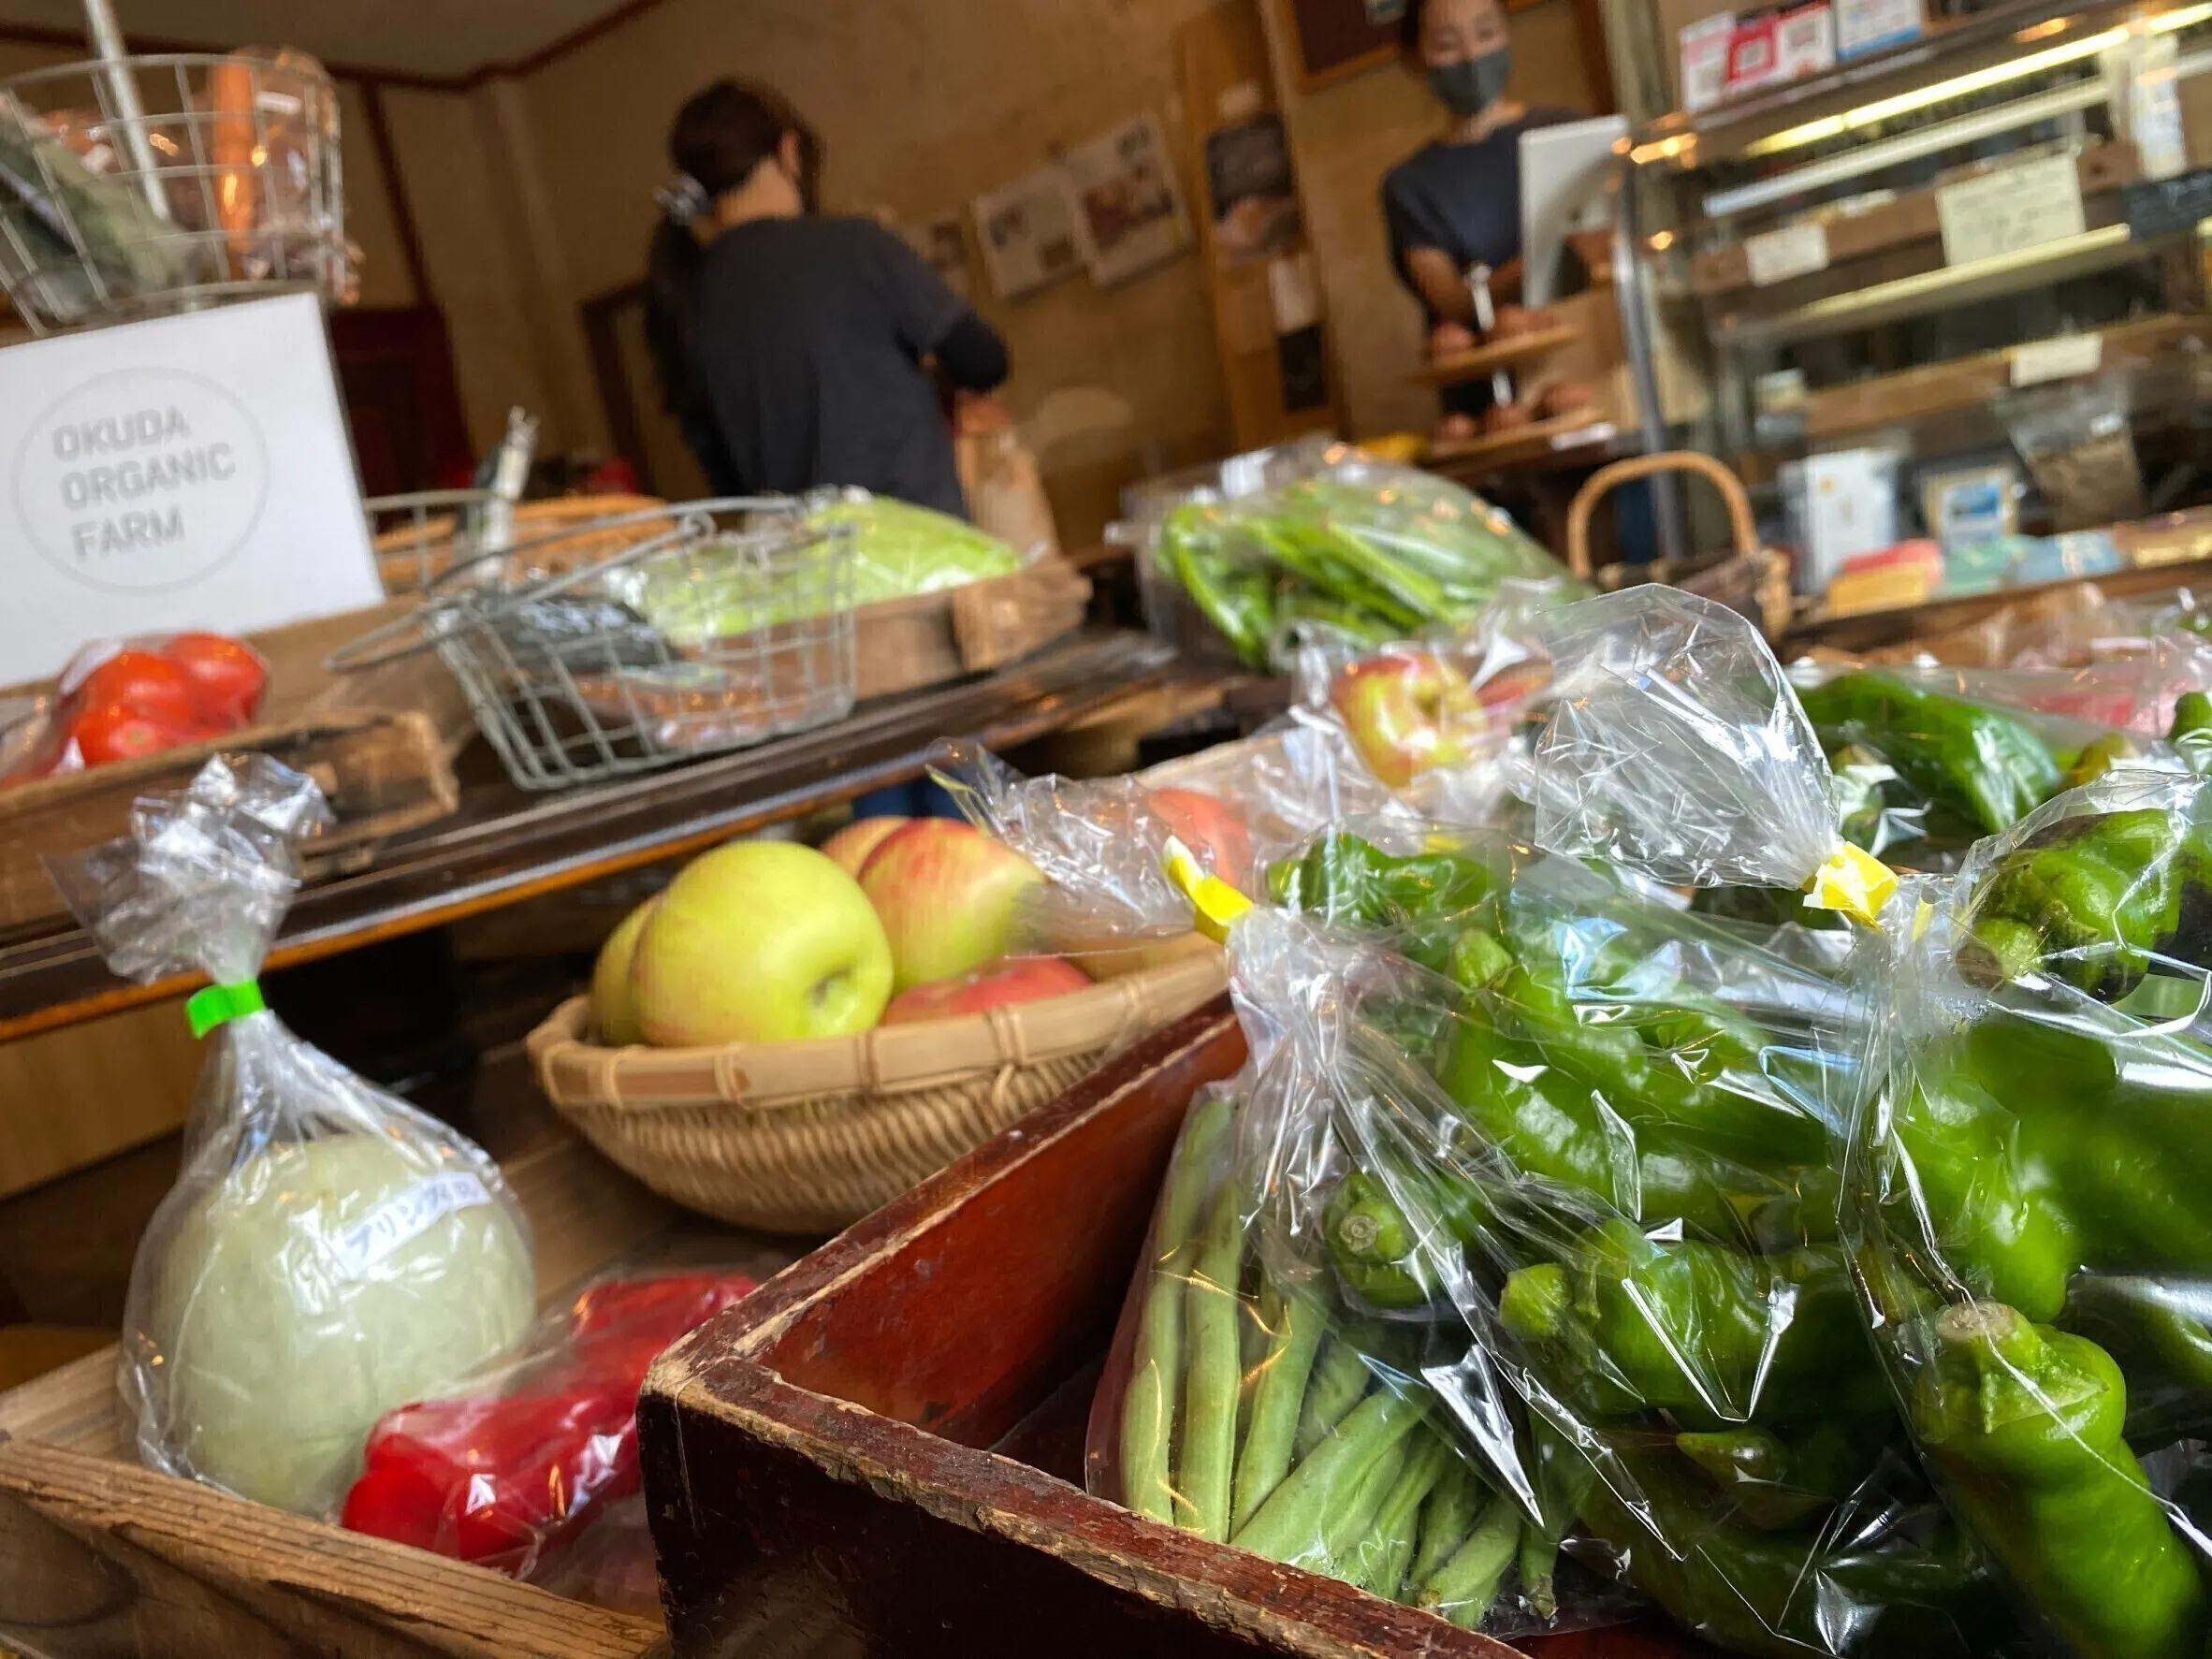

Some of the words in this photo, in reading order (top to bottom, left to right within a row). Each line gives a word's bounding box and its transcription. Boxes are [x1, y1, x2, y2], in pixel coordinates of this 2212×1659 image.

[52, 405, 191, 461] OKUDA
[60, 442, 237, 510] ORGANIC
[71, 505, 186, 561] FARM
